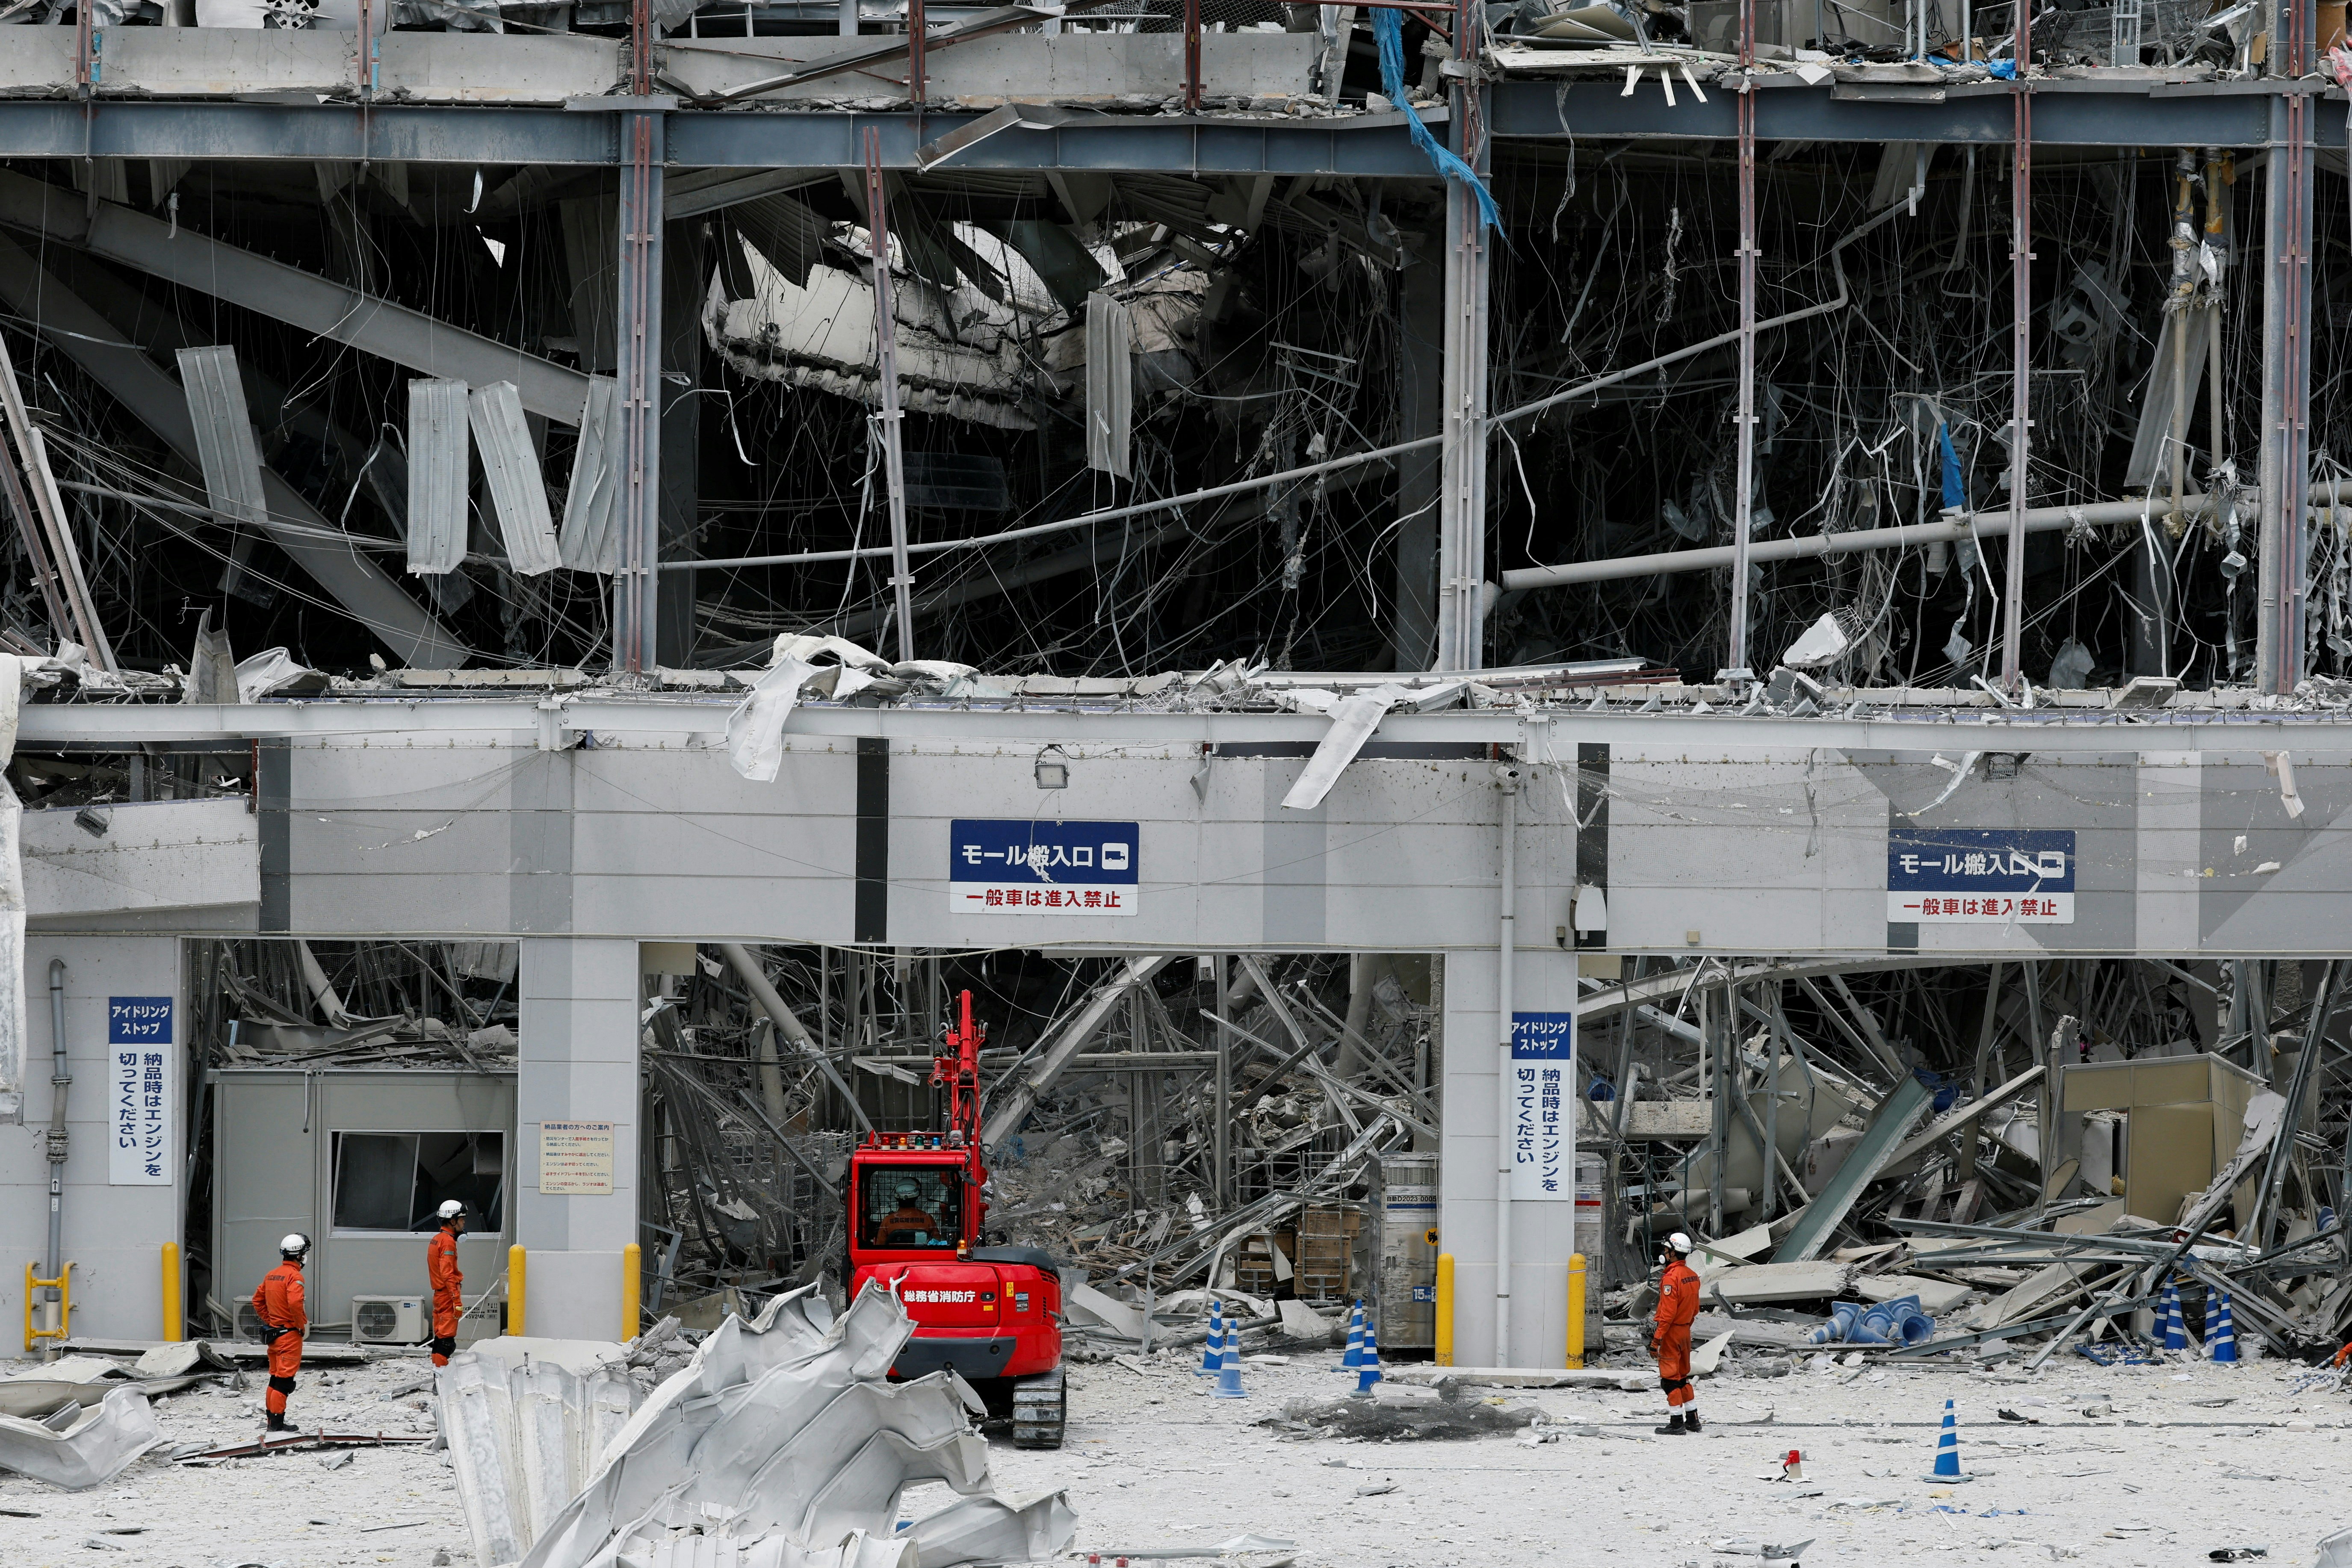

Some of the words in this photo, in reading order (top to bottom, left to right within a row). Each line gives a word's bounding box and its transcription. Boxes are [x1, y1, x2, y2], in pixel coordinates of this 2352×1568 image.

[962, 845, 1093, 867] モール搬入口
[1899, 853, 2029, 876] モール搬入口
[966, 889, 1121, 908] 一般車は進入禁止
[1903, 898, 2058, 916] 一般車は進入禁止
[112, 1005, 170, 1019] アイドリング
[121, 1022, 160, 1035] ストップ
[1512, 1021, 1568, 1034] アイドリング
[1520, 1038, 1558, 1051] ストップ
[119, 1053, 137, 1149] 切ってください
[144, 1053, 163, 1176] 納品時はエンジンを
[1517, 1068, 1535, 1163] 切ってください
[1542, 1068, 1560, 1192] 納品時はエンジンを
[904, 1290, 975, 1303] 総務省消防庁
